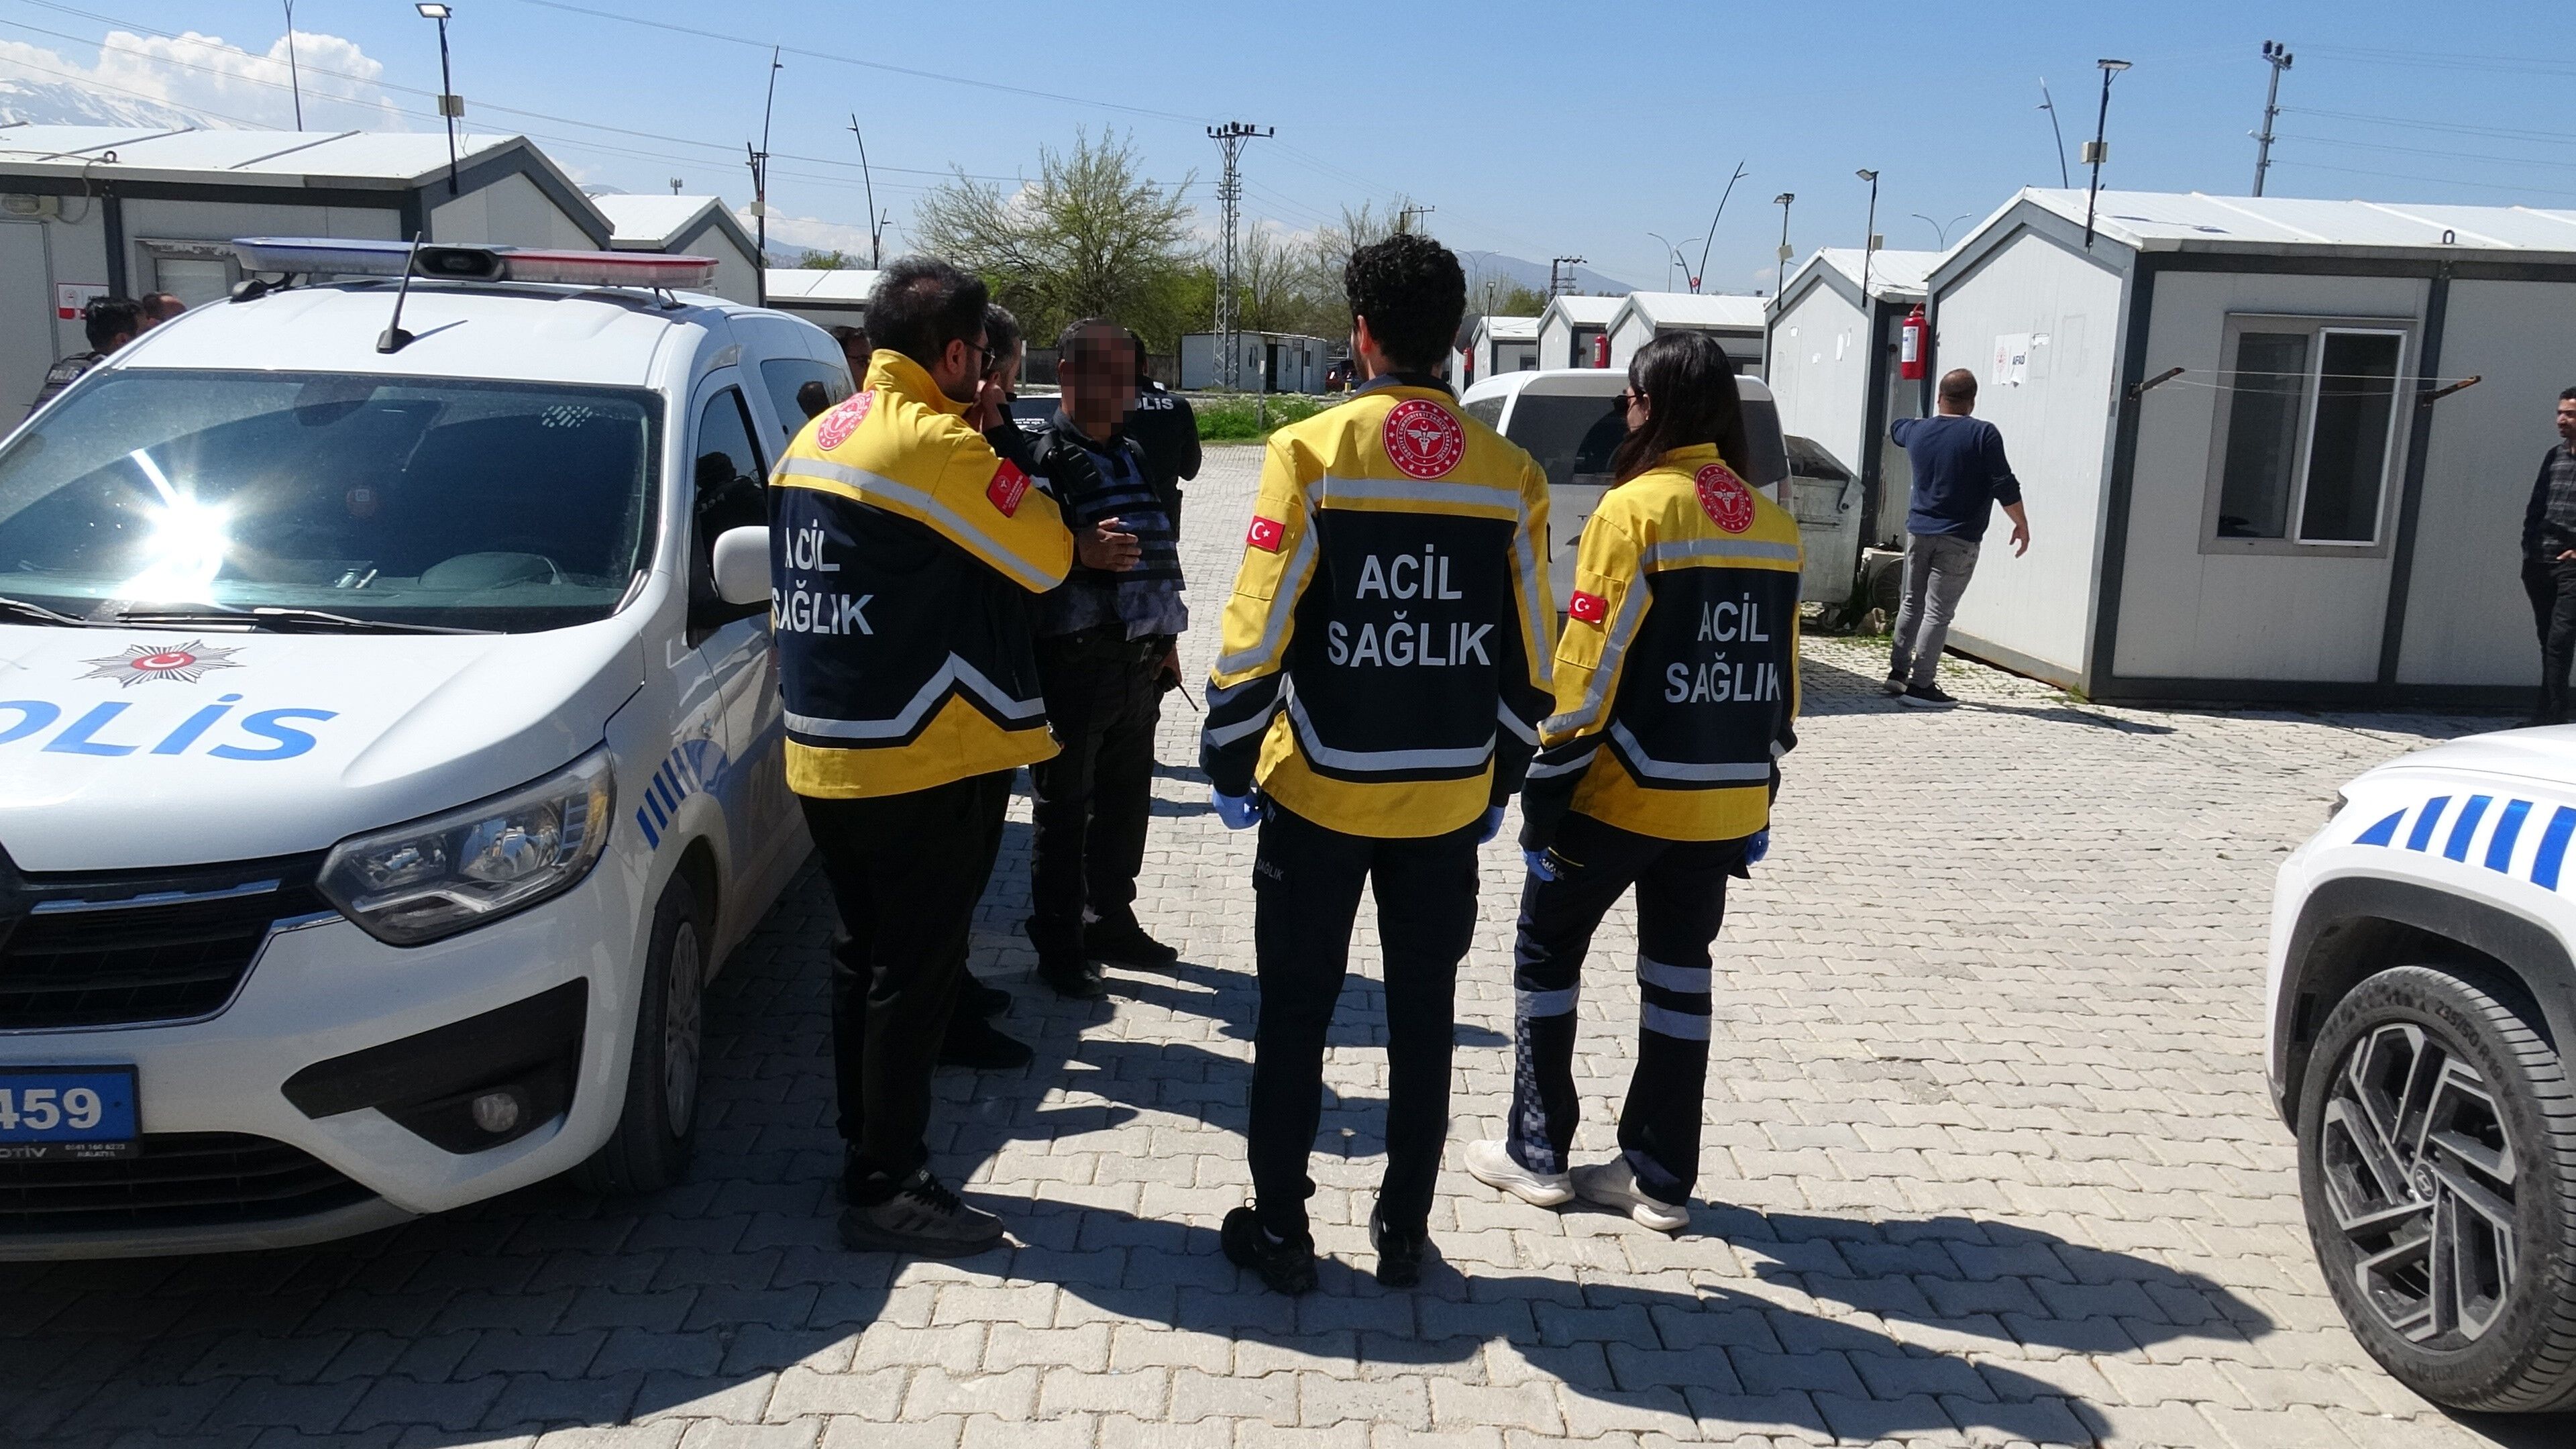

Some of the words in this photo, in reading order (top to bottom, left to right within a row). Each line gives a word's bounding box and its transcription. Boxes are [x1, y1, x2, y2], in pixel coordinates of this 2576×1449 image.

[1138, 397, 1174, 410] LİS
[786, 519, 840, 572] ACİL
[1356, 544, 1462, 600] ACİL
[772, 580, 873, 635] SAĞLIK
[1698, 592, 1769, 642] ACİL
[1328, 610, 1495, 667] SAĞLIK
[1664, 651, 1781, 703] SAĞLIK
